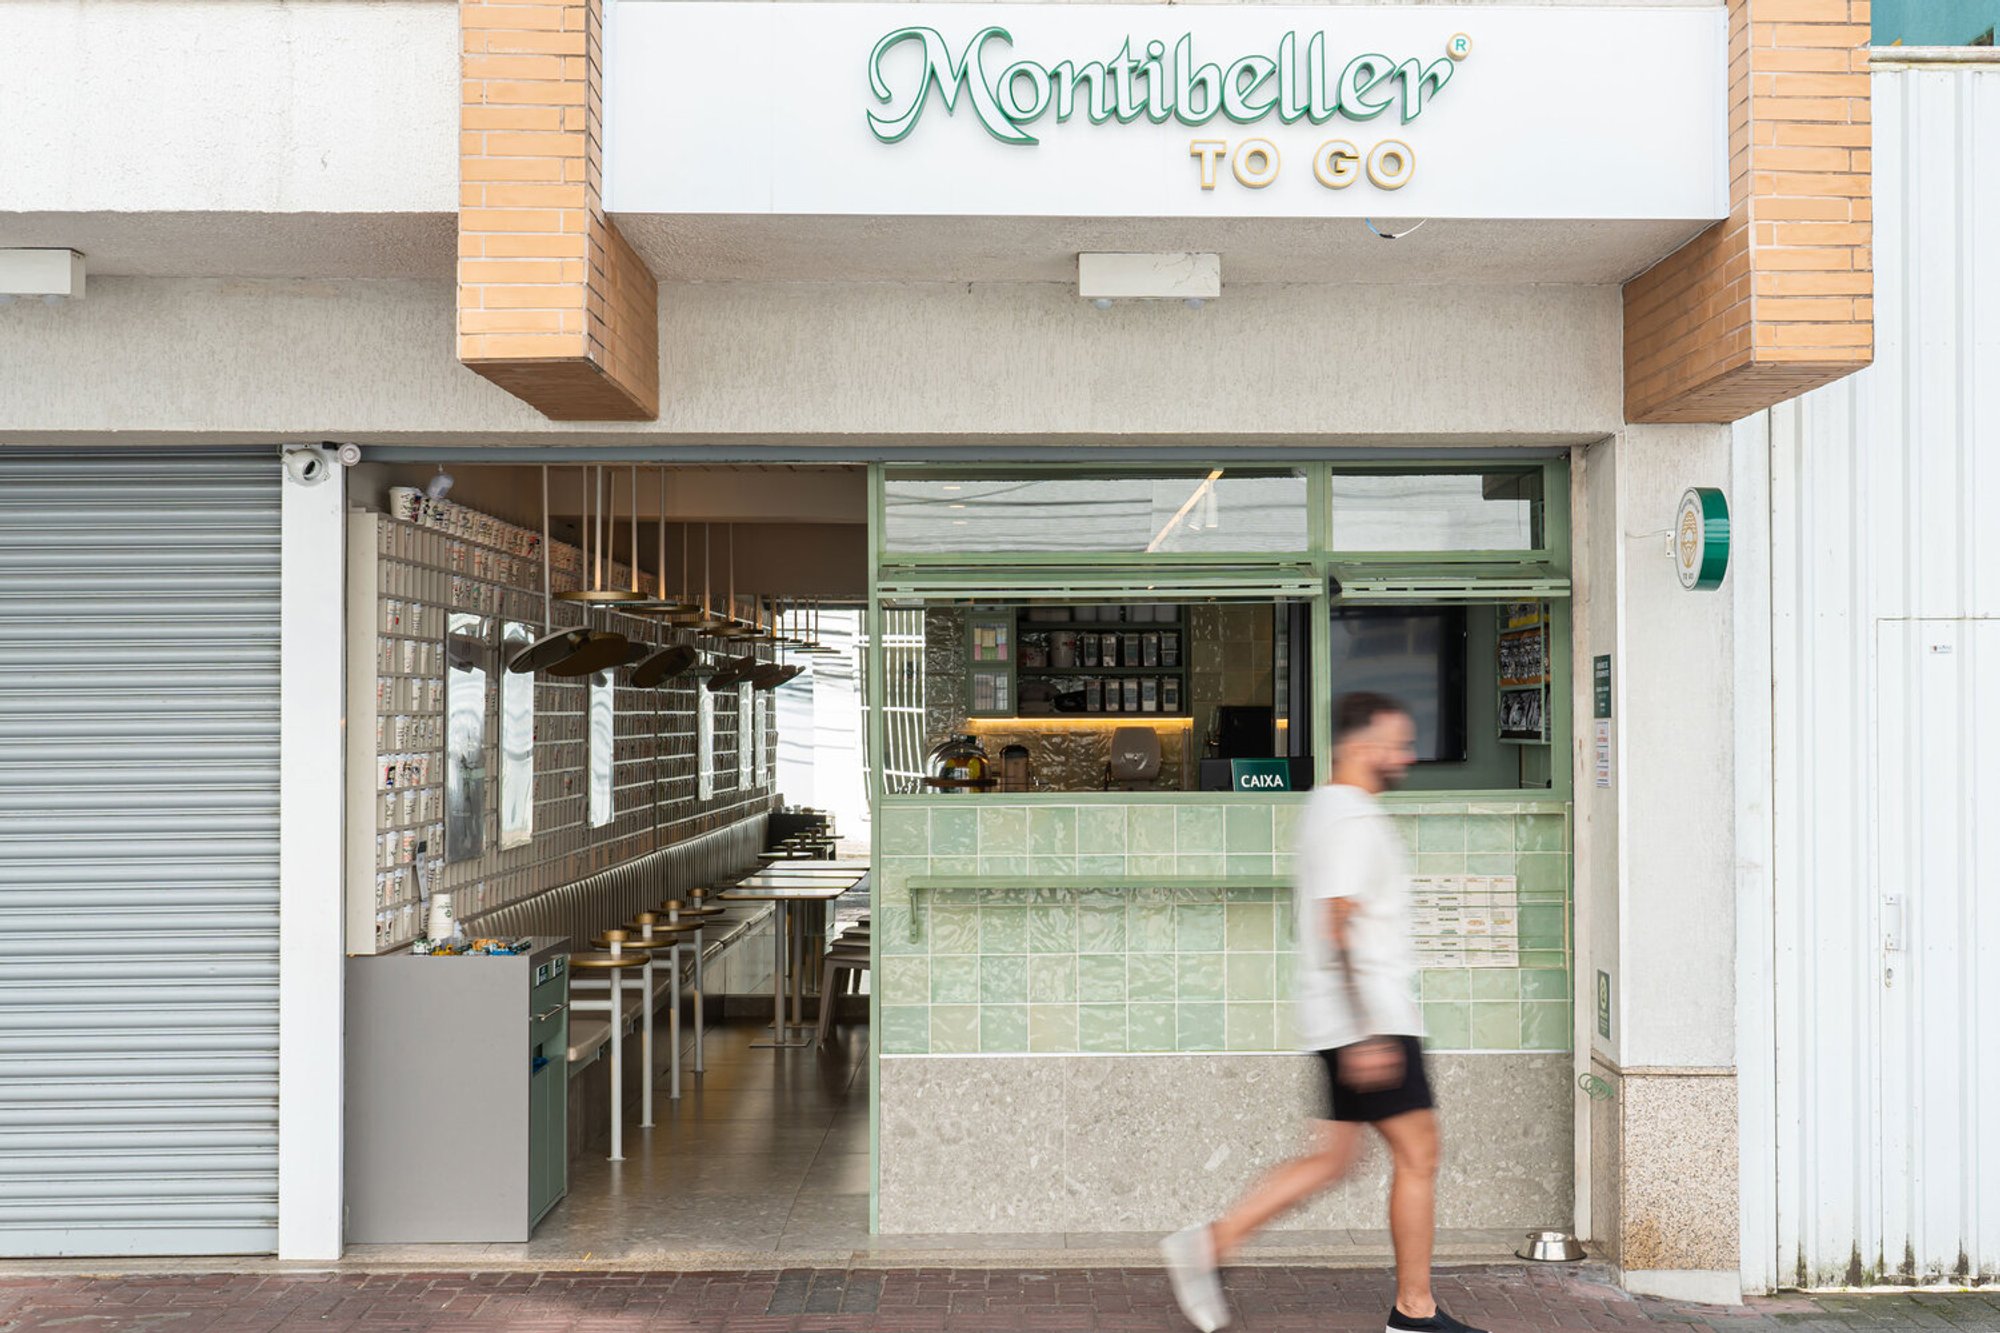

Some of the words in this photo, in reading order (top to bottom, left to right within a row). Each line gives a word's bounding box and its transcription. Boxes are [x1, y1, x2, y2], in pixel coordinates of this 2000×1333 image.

[866, 26, 1454, 145] Montibeller
[1190, 139, 1280, 189] TO
[1314, 139, 1416, 190] GO
[1241, 775, 1284, 788] CAIXA
